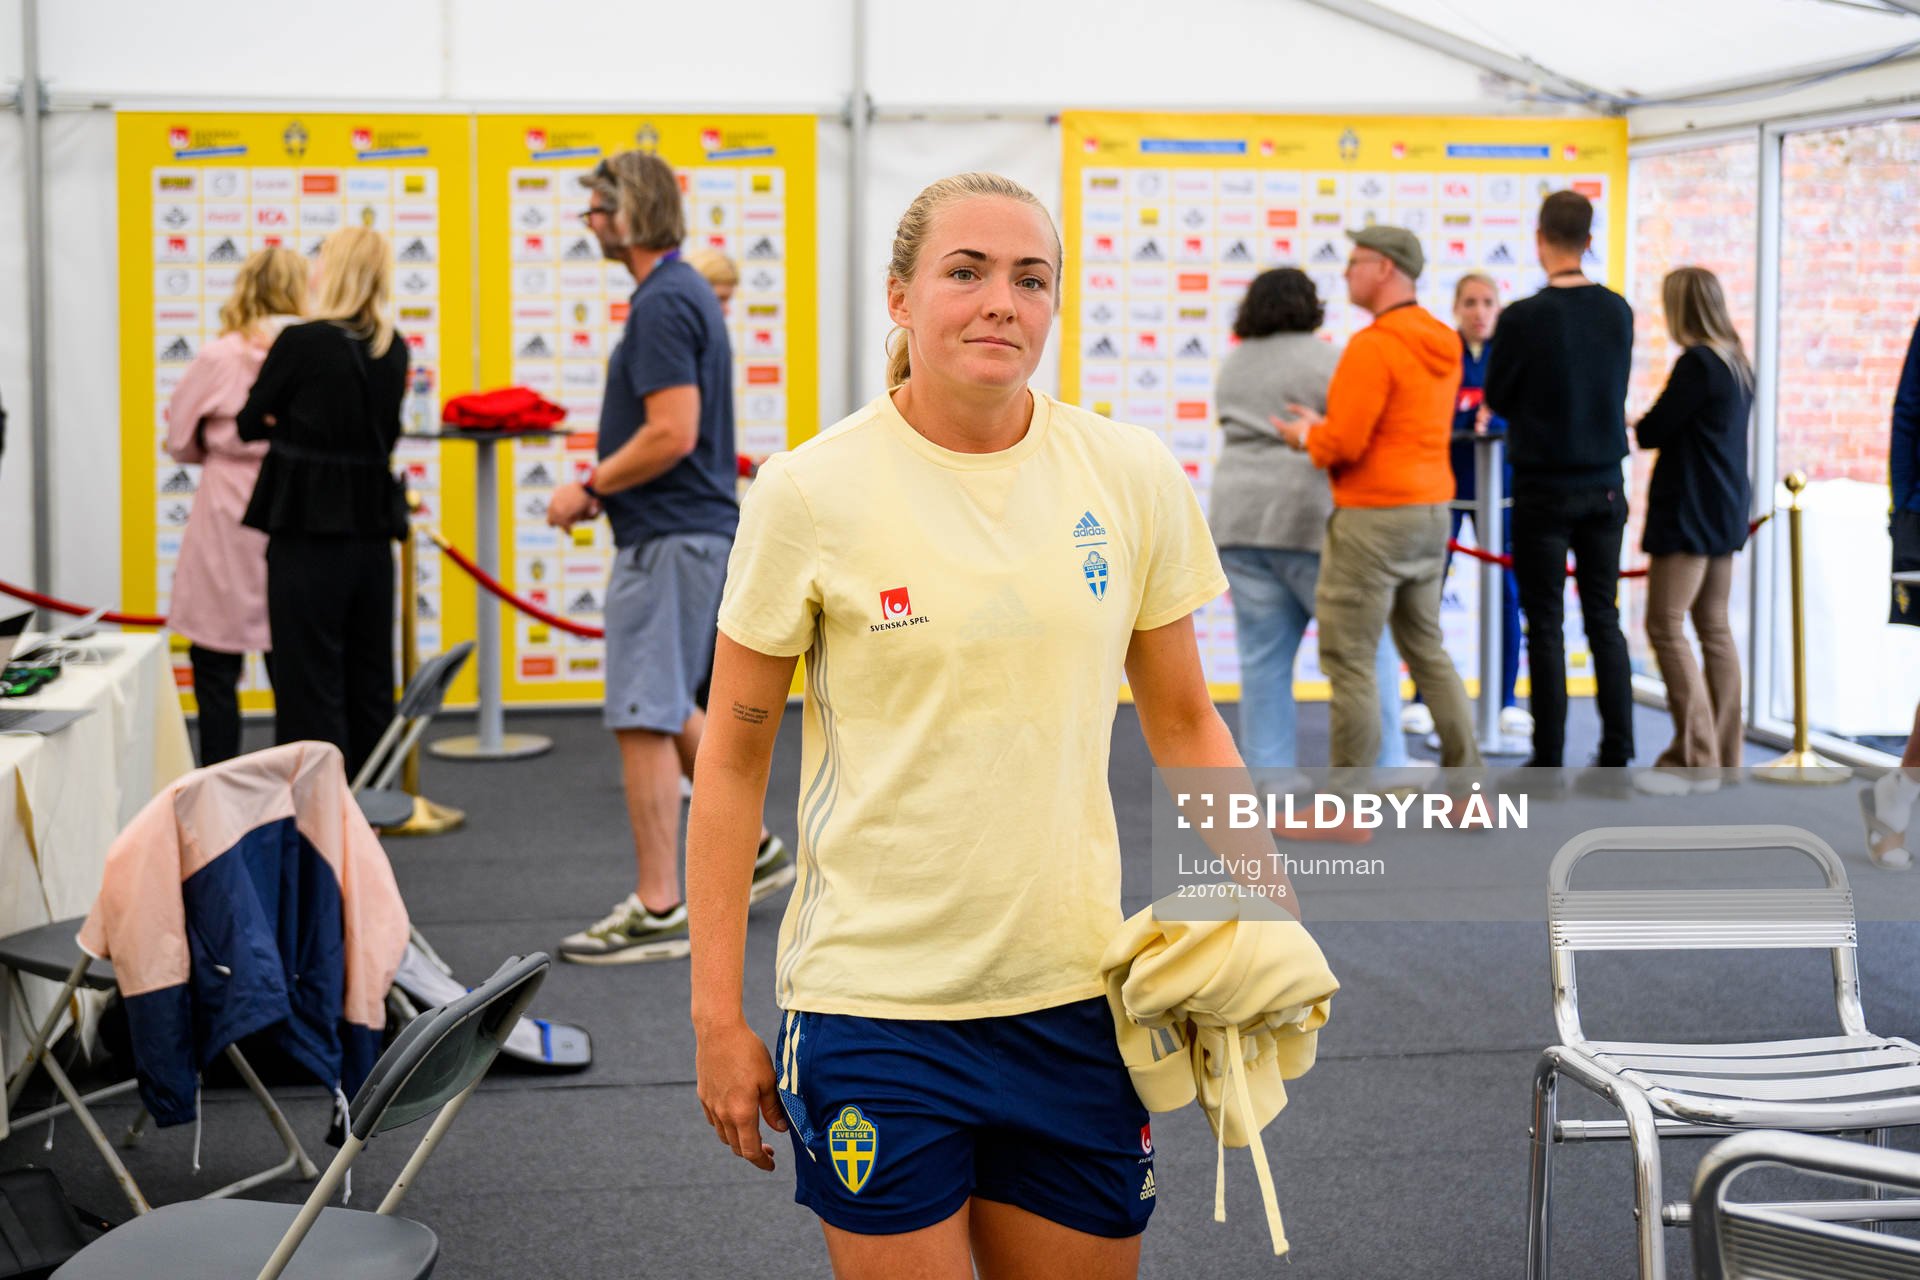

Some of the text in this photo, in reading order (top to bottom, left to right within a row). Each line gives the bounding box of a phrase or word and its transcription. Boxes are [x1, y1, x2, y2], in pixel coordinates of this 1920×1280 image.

[1073, 527, 1106, 537] adidas
[870, 616, 930, 632] SVENSKA SPEL
[836, 1131, 868, 1139] SVERIGE
